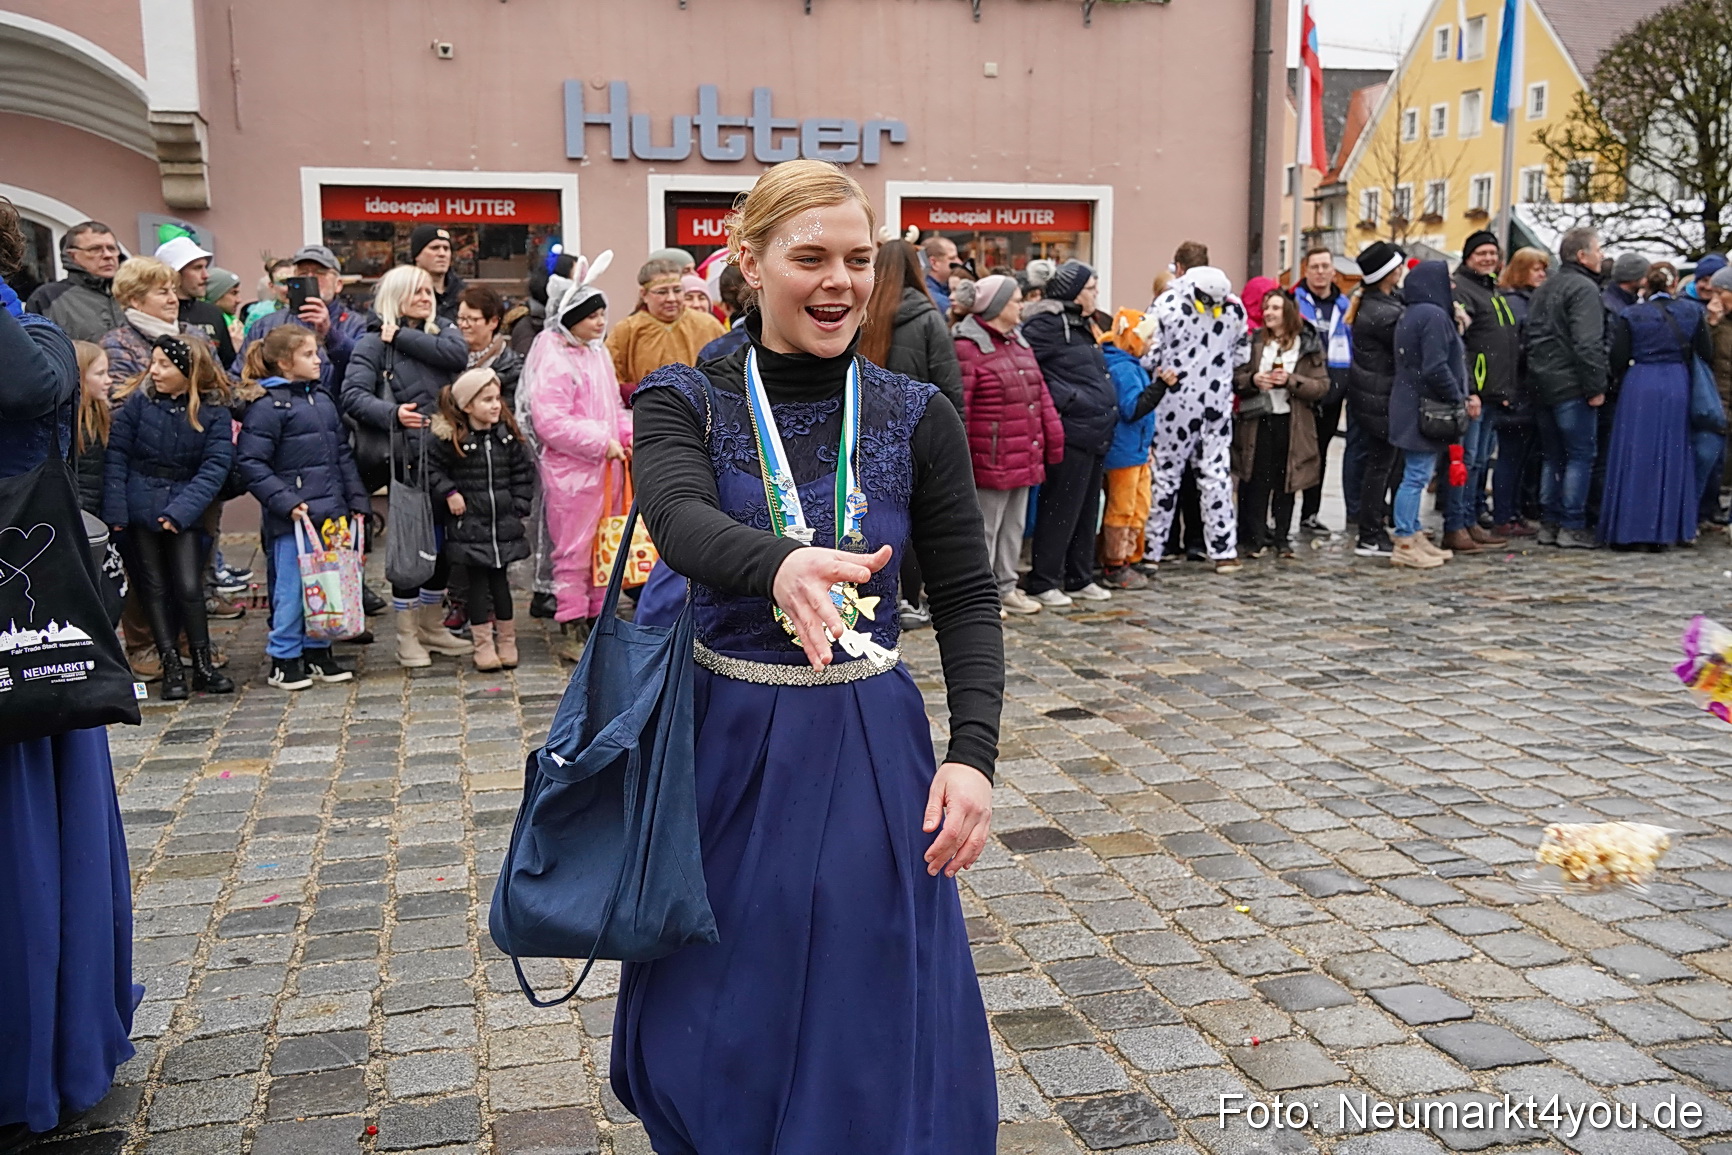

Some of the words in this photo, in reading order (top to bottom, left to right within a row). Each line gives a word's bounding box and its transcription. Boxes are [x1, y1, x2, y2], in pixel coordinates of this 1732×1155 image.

[564, 79, 907, 164] Hutter
[446, 199, 516, 216] HUTTER
[995, 209, 1055, 225] HUTTER
[24, 645, 41, 653] Trade
[23, 661, 85, 679] NEUMARKT
